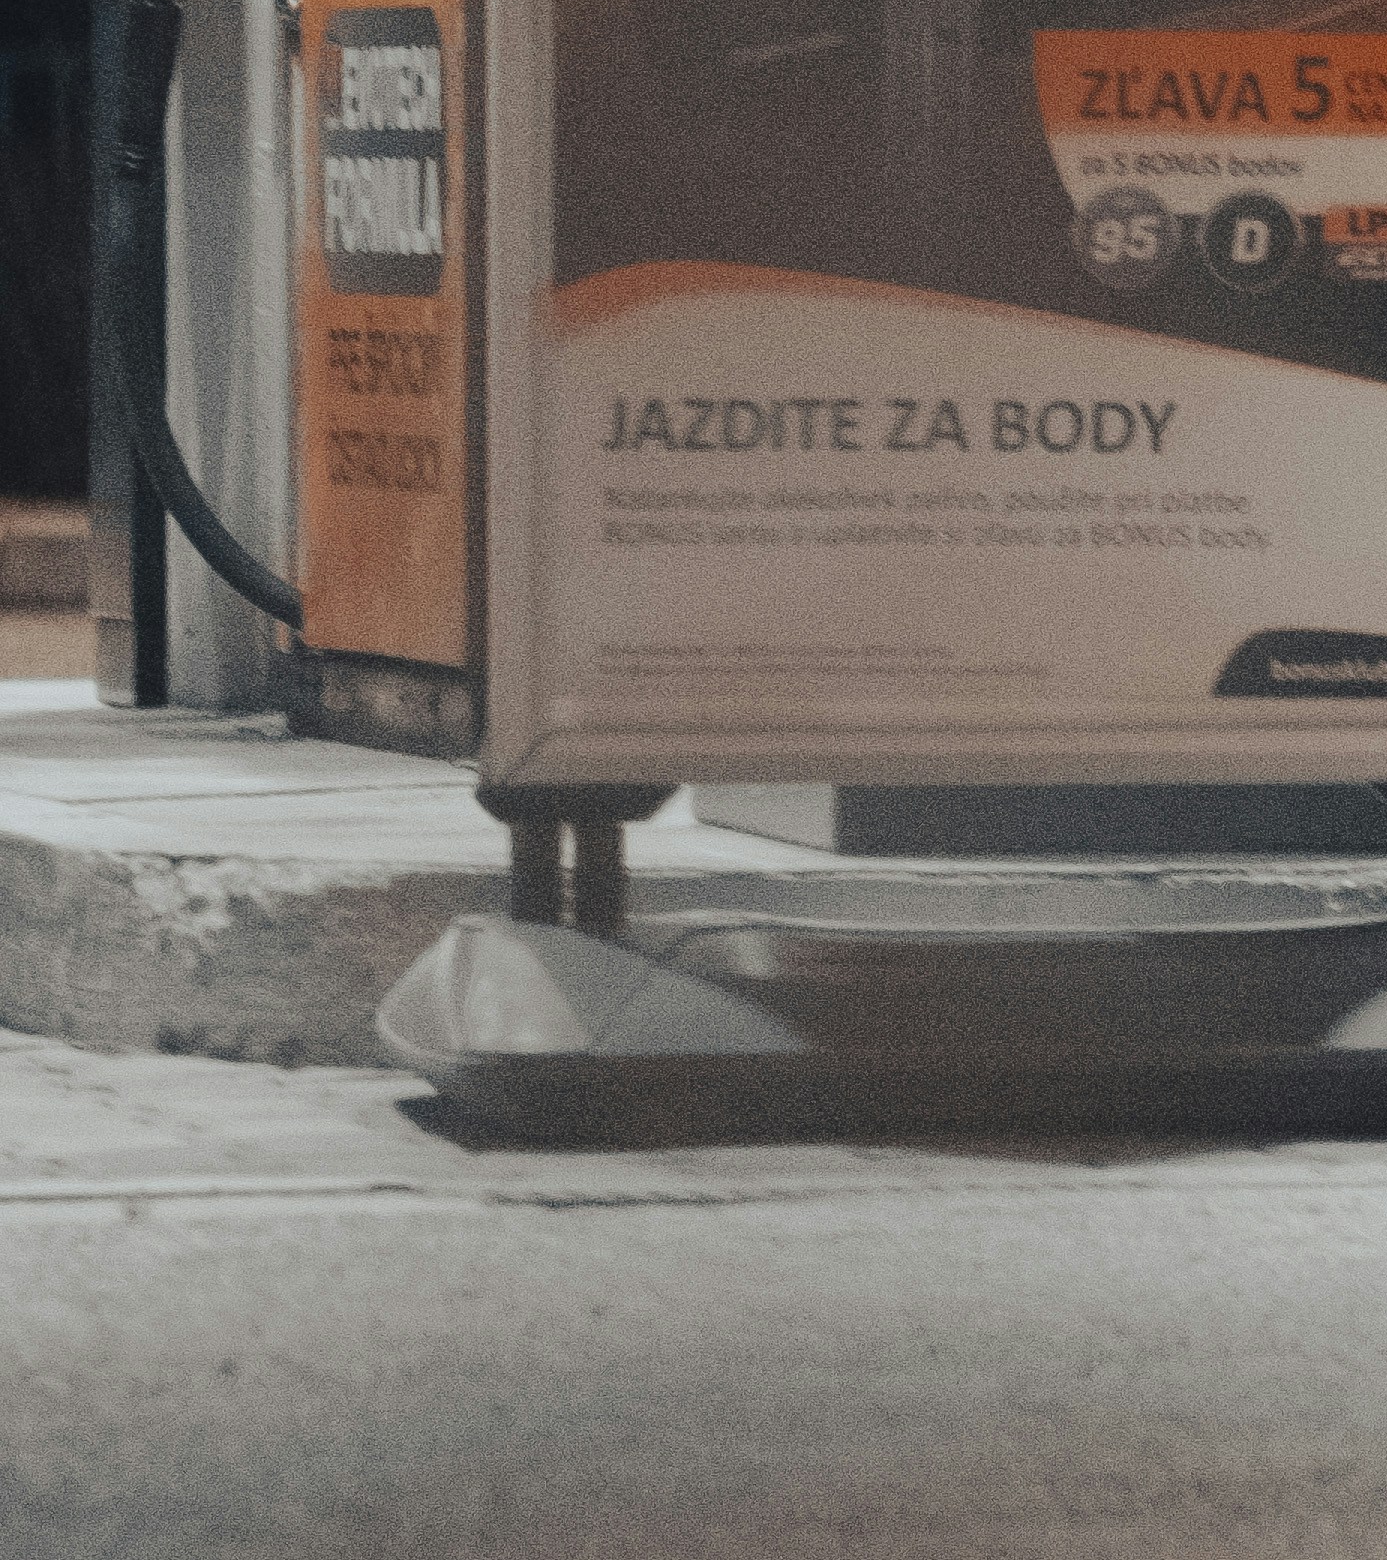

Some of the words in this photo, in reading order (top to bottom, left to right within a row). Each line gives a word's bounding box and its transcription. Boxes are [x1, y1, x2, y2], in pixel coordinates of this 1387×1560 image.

[1291, 55, 1332, 123] 5
[1091, 214, 1161, 264] 95
[1230, 218, 1271, 264] D
[601, 400, 862, 453] JAZDITE
[883, 400, 970, 453] ZA
[993, 400, 1178, 454] BODY
